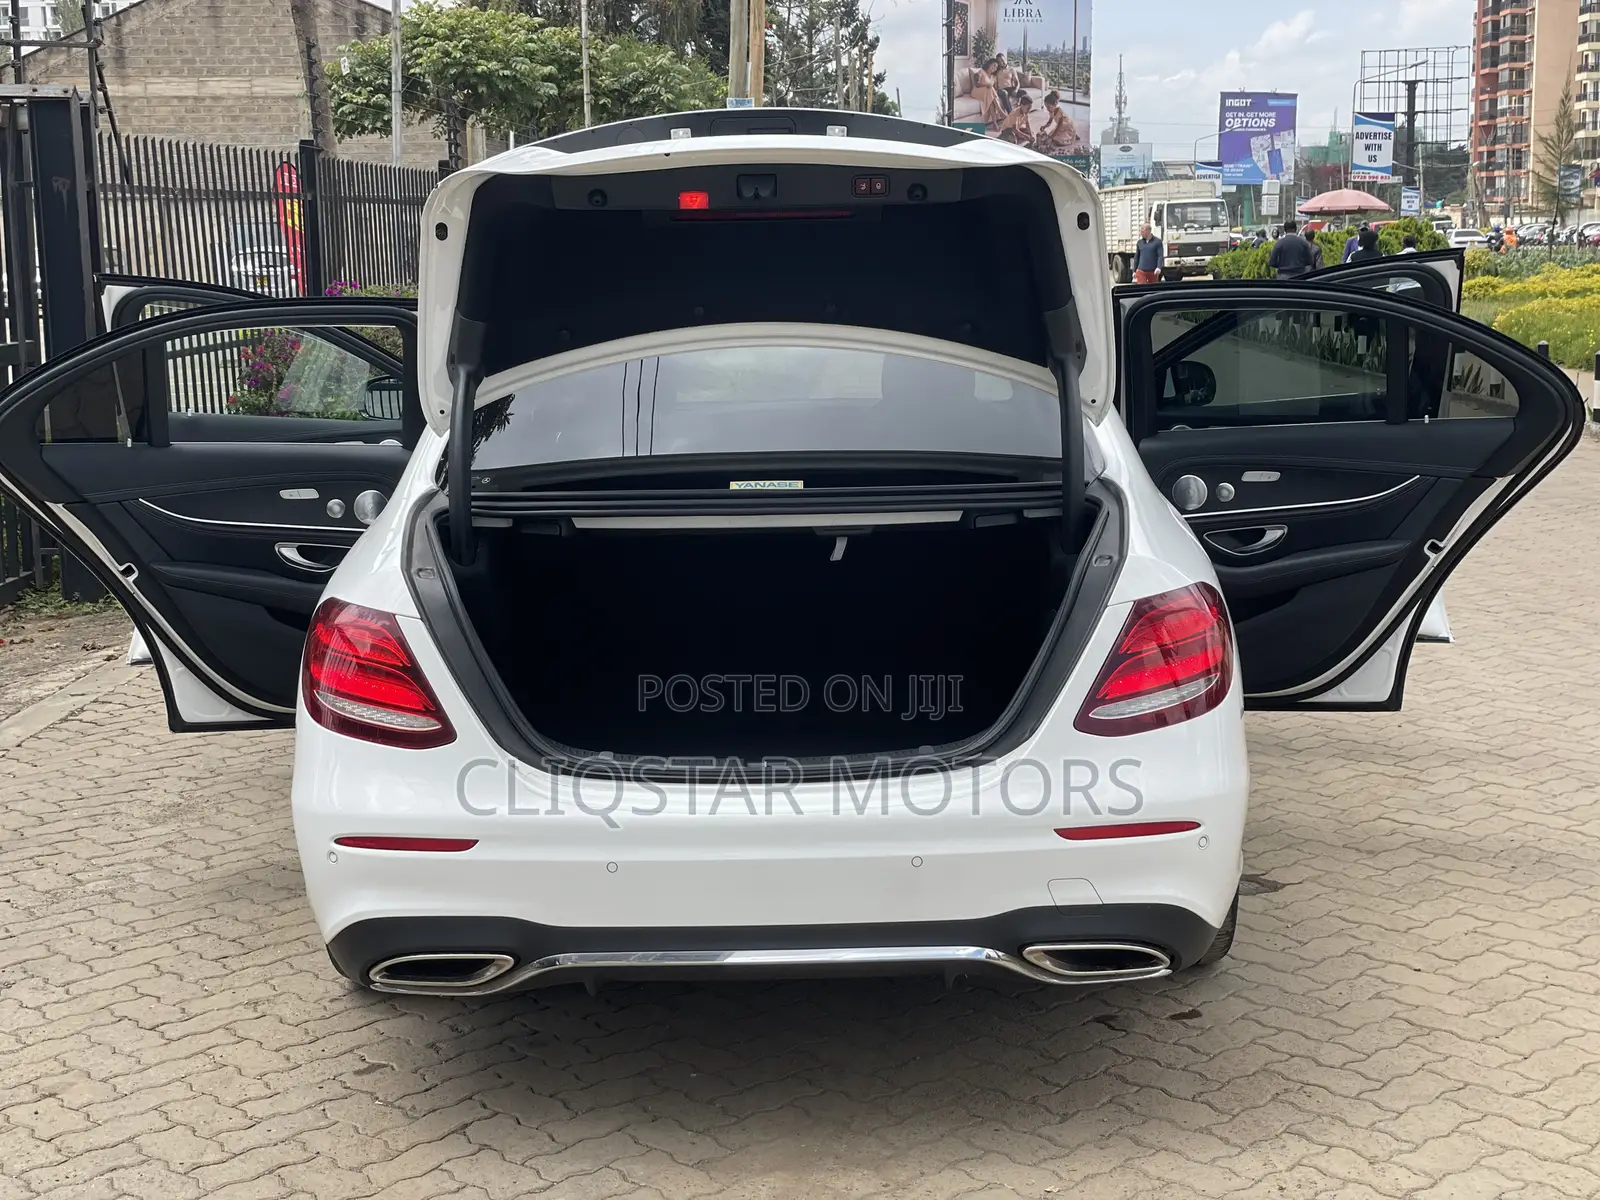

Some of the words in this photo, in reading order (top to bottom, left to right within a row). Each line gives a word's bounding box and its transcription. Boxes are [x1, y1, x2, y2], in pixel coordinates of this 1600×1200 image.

[1004, 8, 1042, 18] LIBRA
[1225, 98, 1252, 107] INGOT
[1225, 118, 1276, 128] OPTIONS
[1355, 131, 1392, 141] ADVERTISE
[1364, 143, 1382, 152] WITH
[1368, 154, 1378, 163] US
